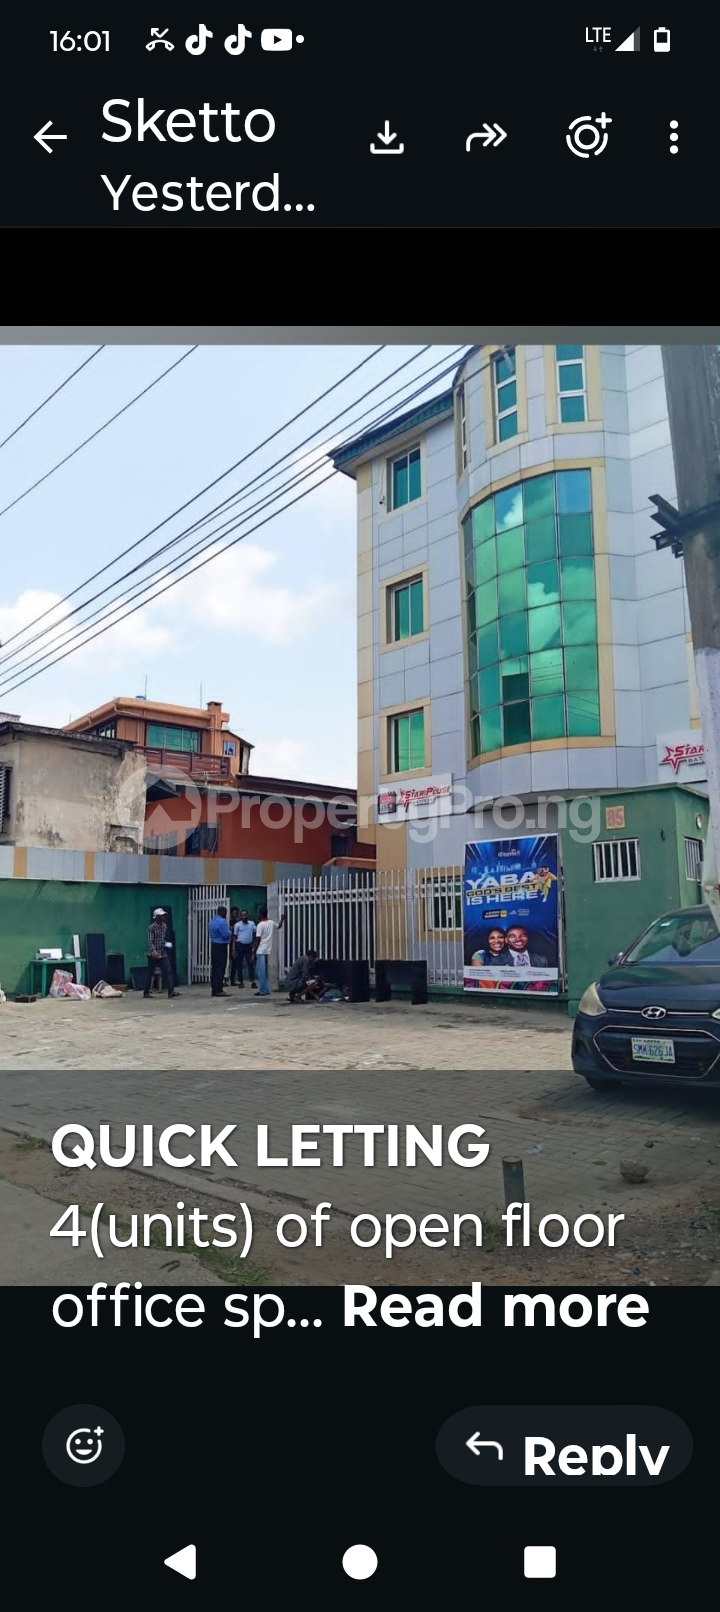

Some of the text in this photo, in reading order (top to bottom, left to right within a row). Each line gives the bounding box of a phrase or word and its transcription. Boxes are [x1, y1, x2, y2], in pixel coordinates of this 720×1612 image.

[466, 871, 537, 890] YABA
[466, 889, 539, 906] IS HERE
